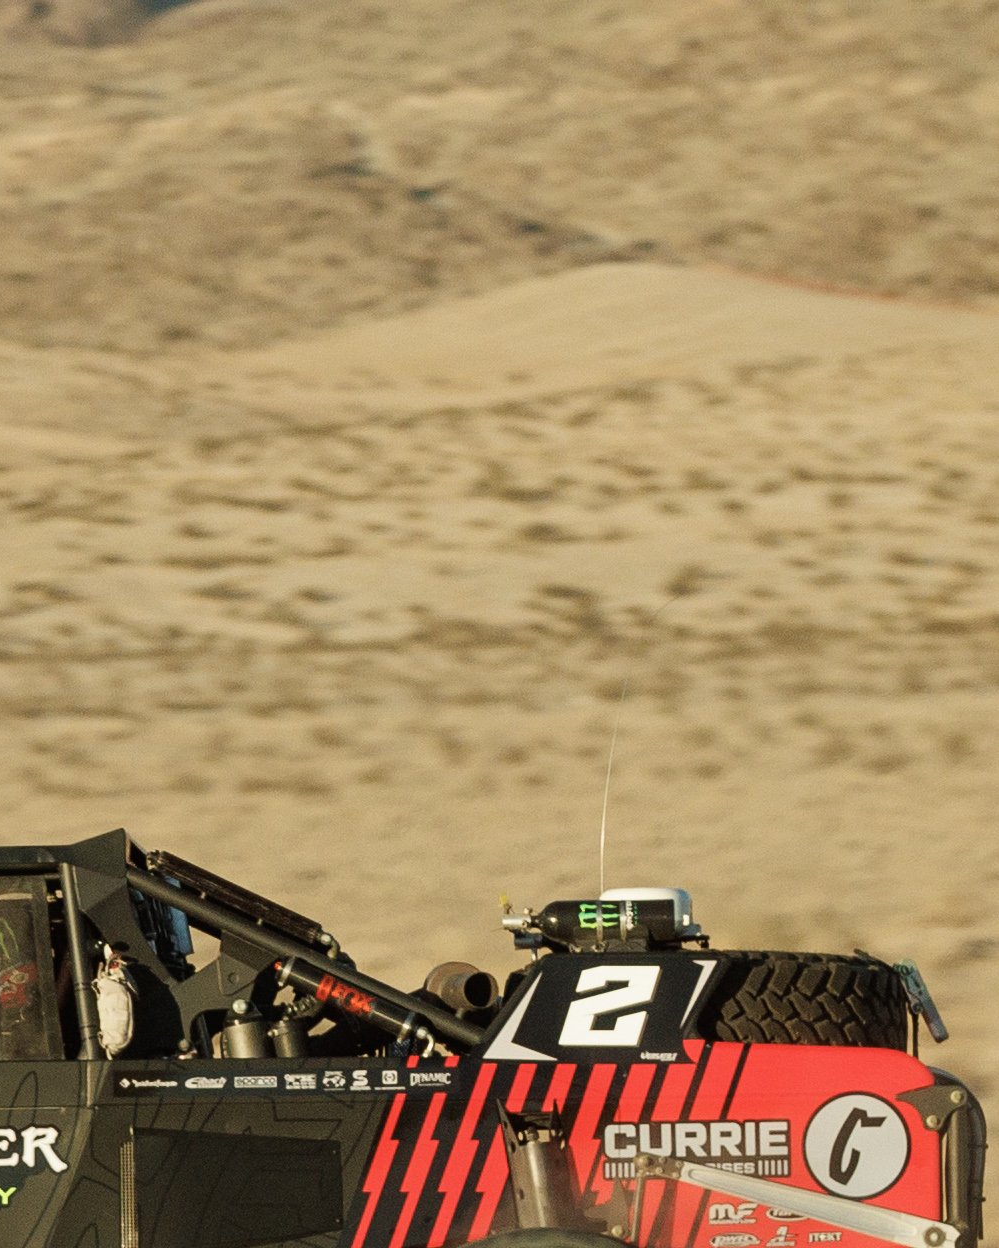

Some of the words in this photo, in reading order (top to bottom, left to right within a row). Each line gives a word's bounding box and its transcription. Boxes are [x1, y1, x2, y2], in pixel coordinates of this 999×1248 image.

[558, 965, 662, 1047] 2
[410, 1072, 451, 1086] DYNAMIC
[604, 1121, 789, 1159] CURRIE
